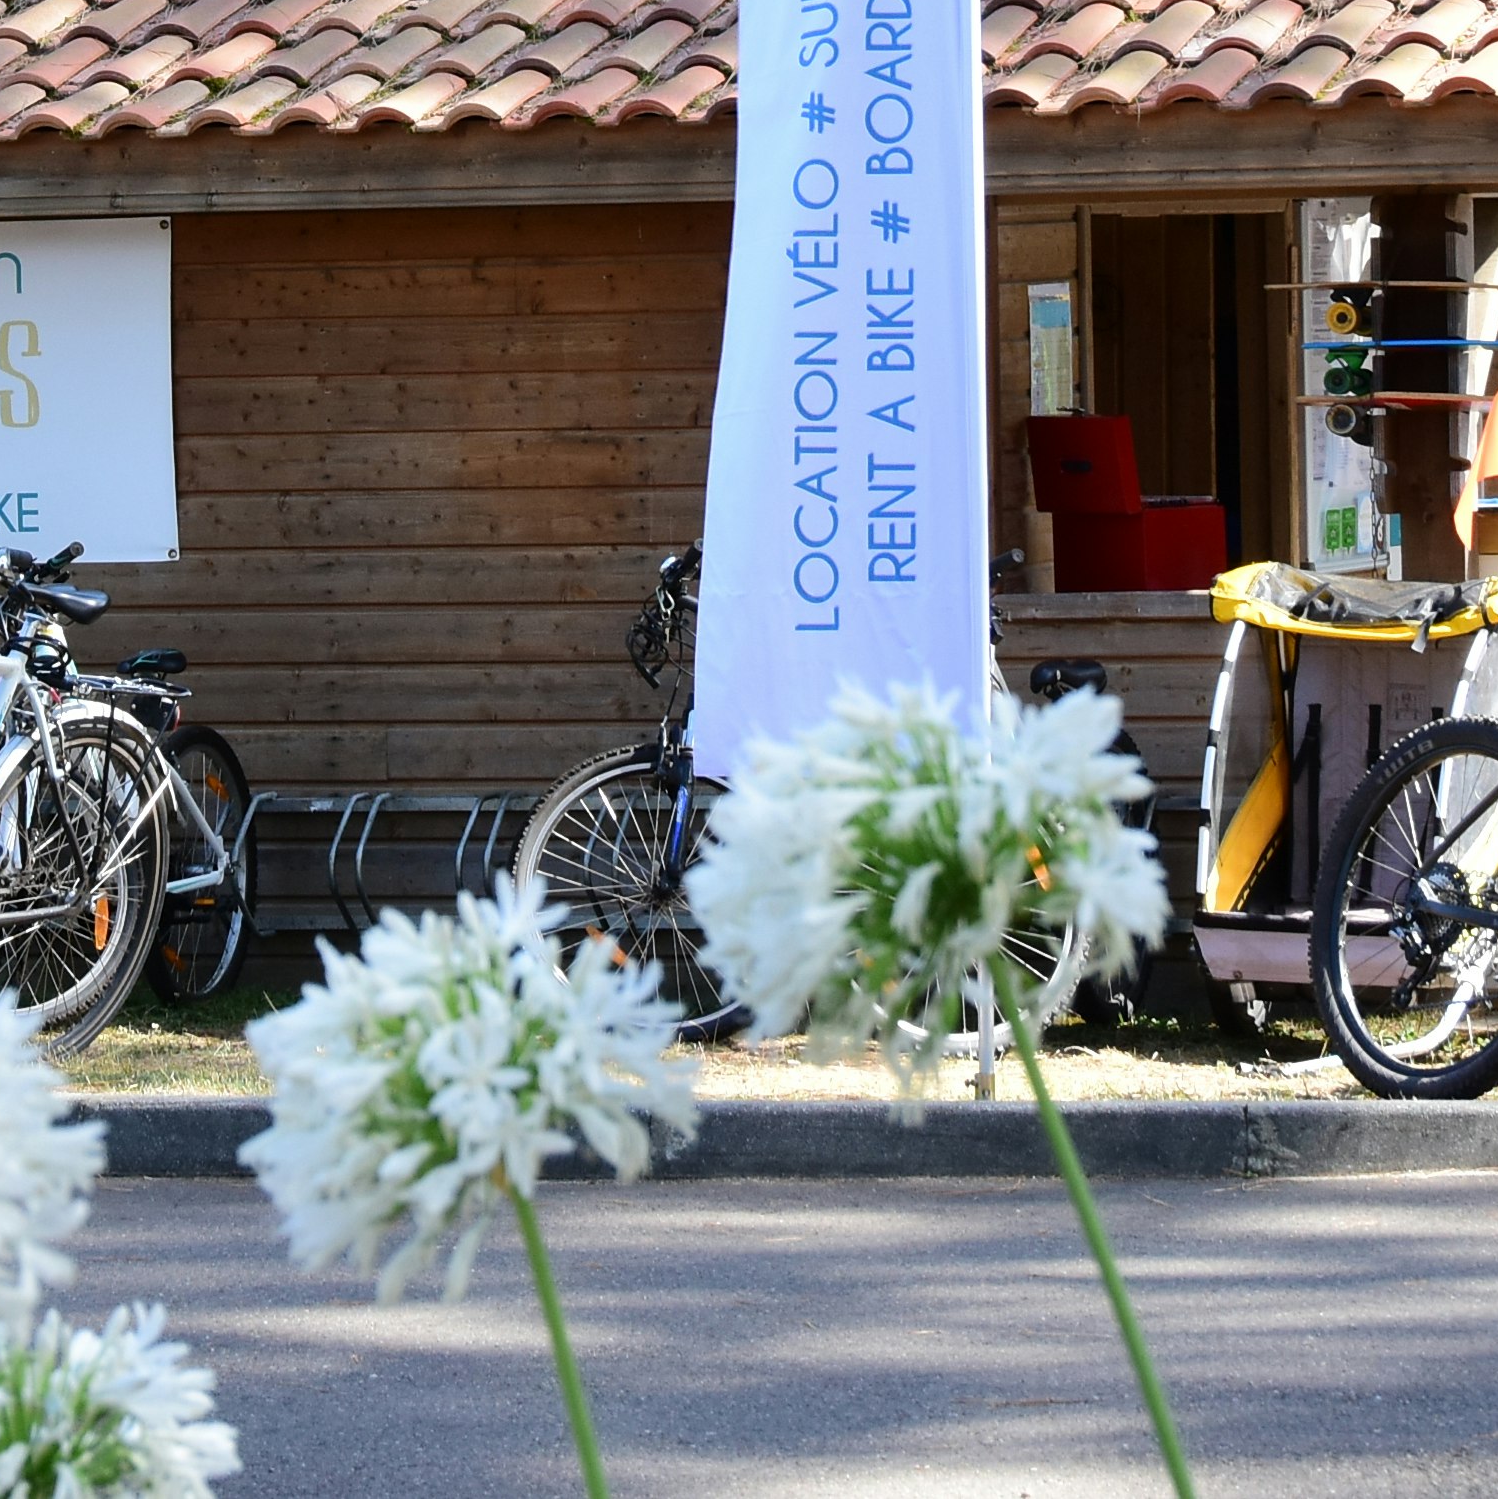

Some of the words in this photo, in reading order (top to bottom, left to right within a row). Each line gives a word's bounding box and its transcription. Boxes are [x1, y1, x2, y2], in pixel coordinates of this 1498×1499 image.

[802, 91, 836, 134] #
[784, 157, 839, 309] VÉLO
[870, 199, 911, 244] #
[866, 268, 915, 372] BIKE
[867, 394, 916, 432] A
[794, 331, 839, 631] LOCATION
[867, 452, 917, 583] RENT
